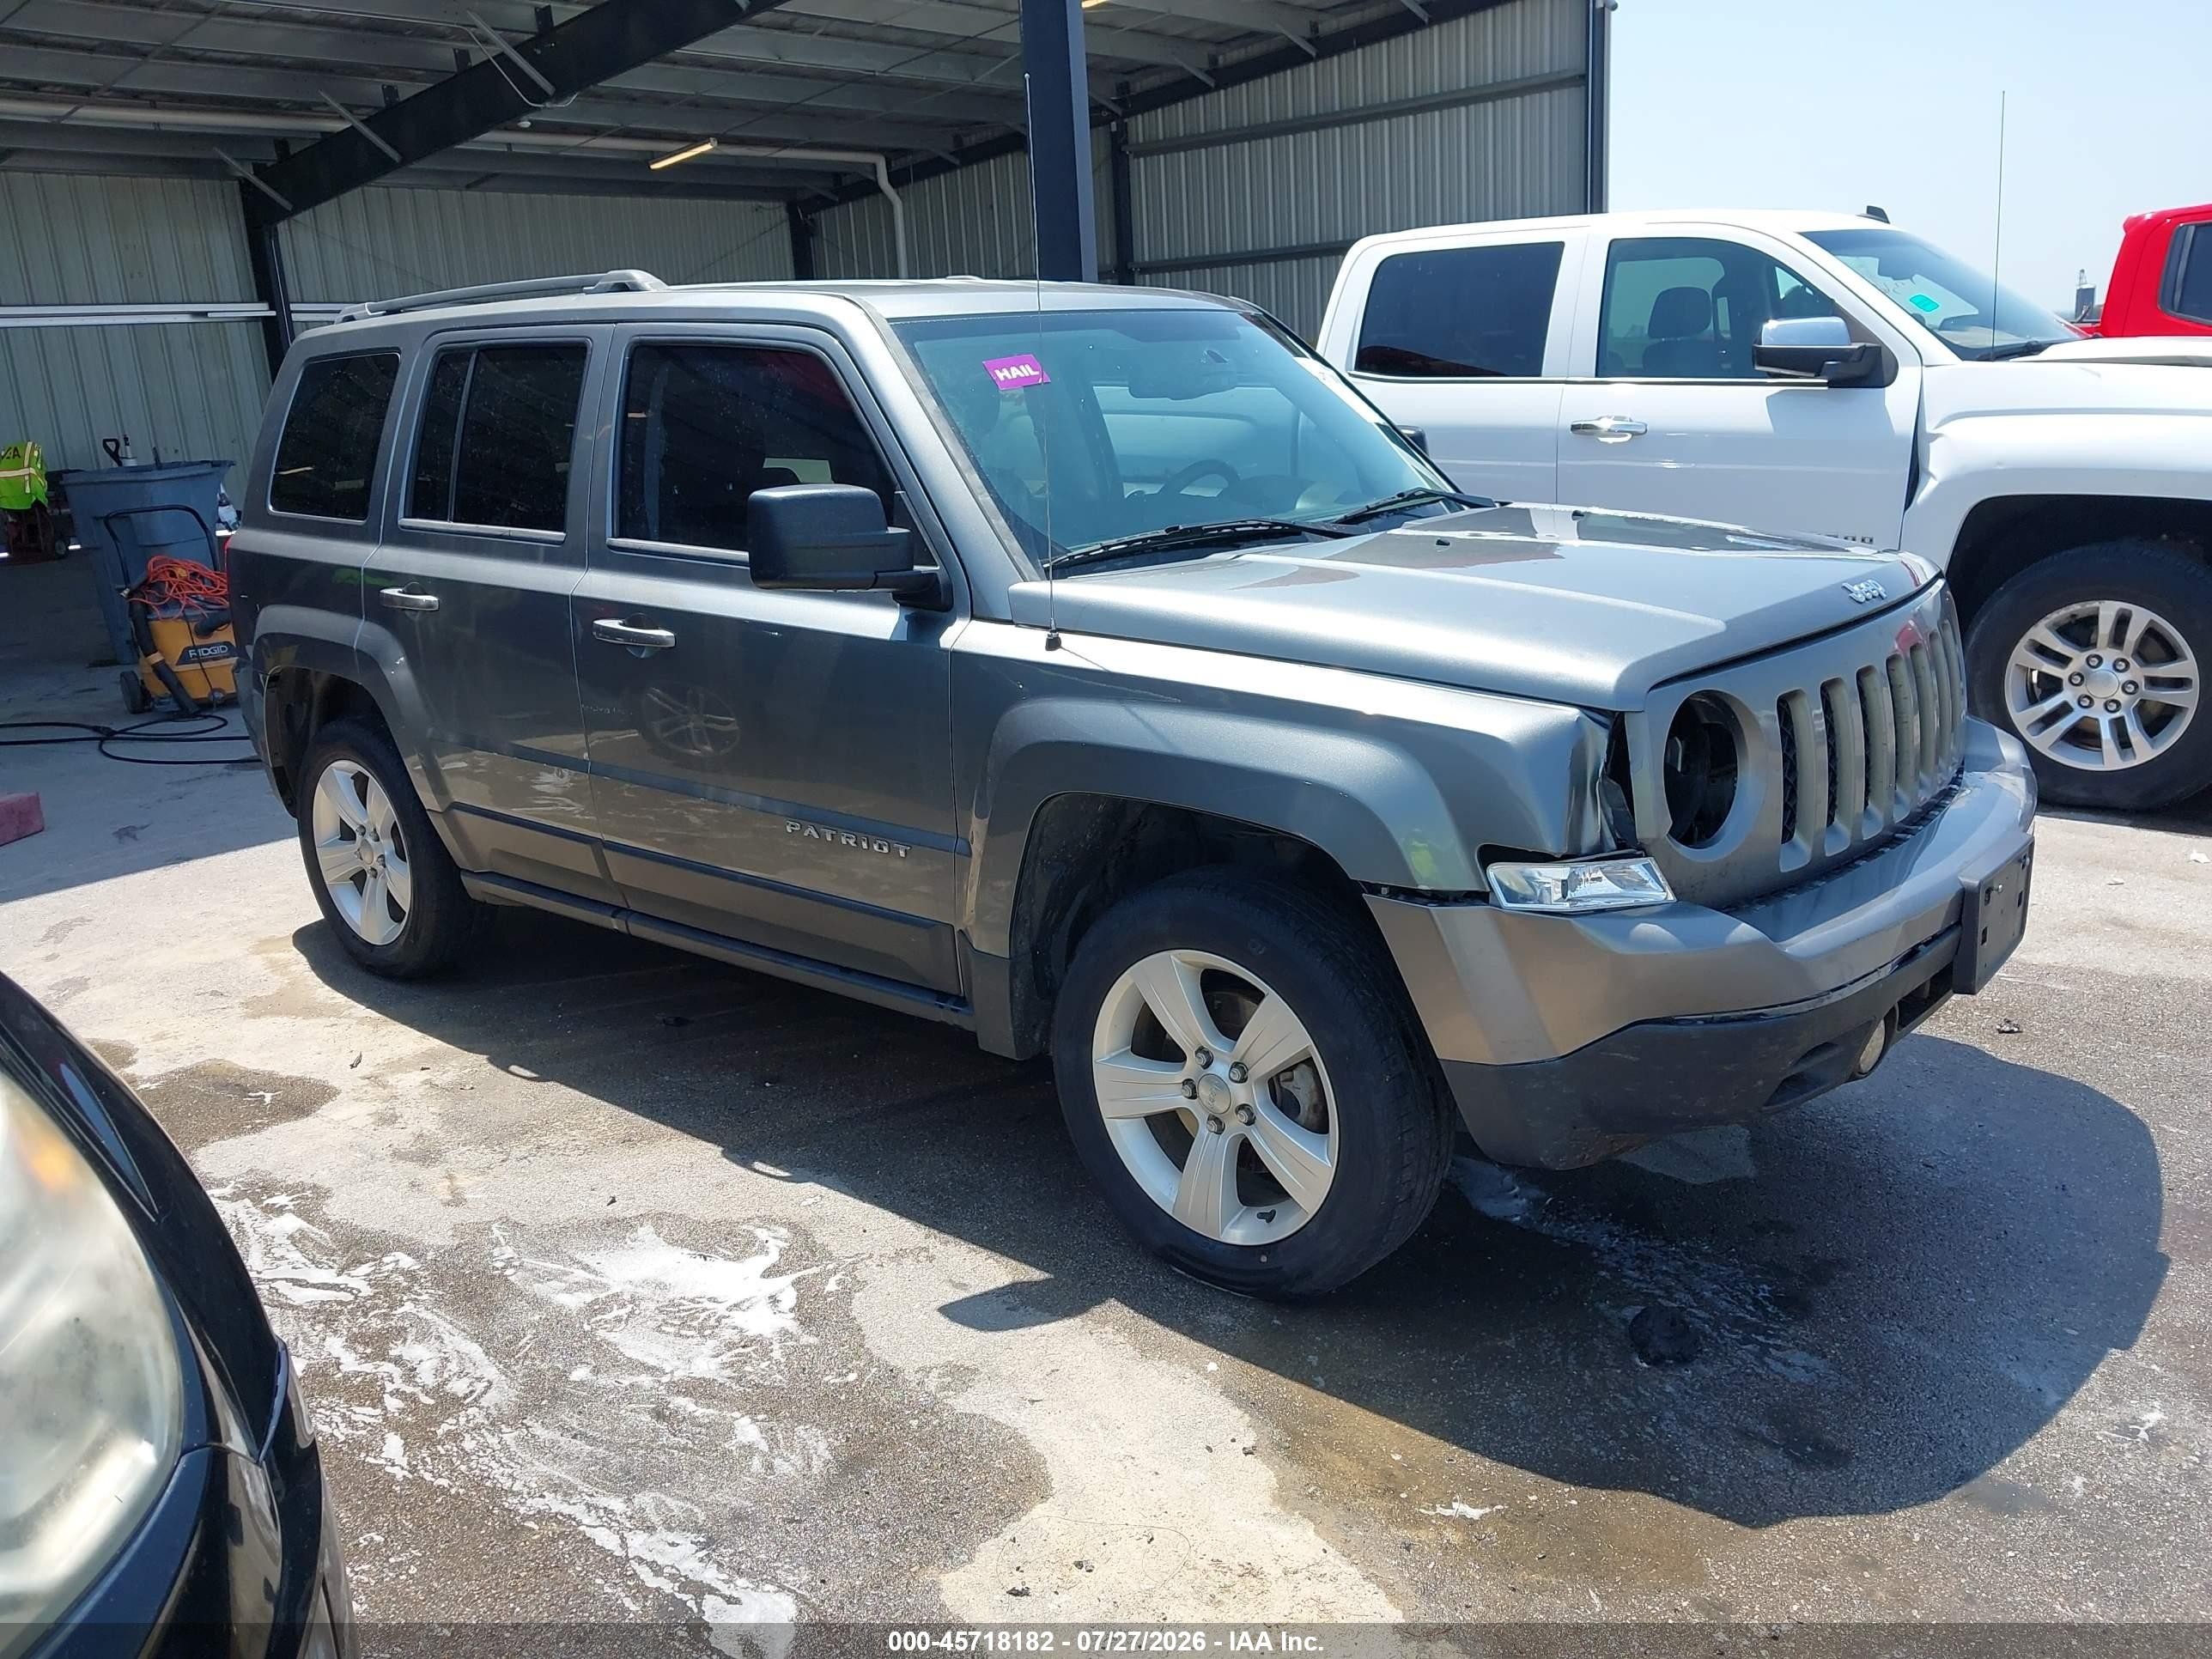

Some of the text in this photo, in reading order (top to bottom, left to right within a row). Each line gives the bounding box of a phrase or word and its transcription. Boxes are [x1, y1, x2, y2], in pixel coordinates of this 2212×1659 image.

[994, 363, 1040, 382] HAIL
[1841, 579, 1887, 603] Jeep
[188, 645, 228, 659] RIDGID
[785, 819, 912, 858] PATRIOT
